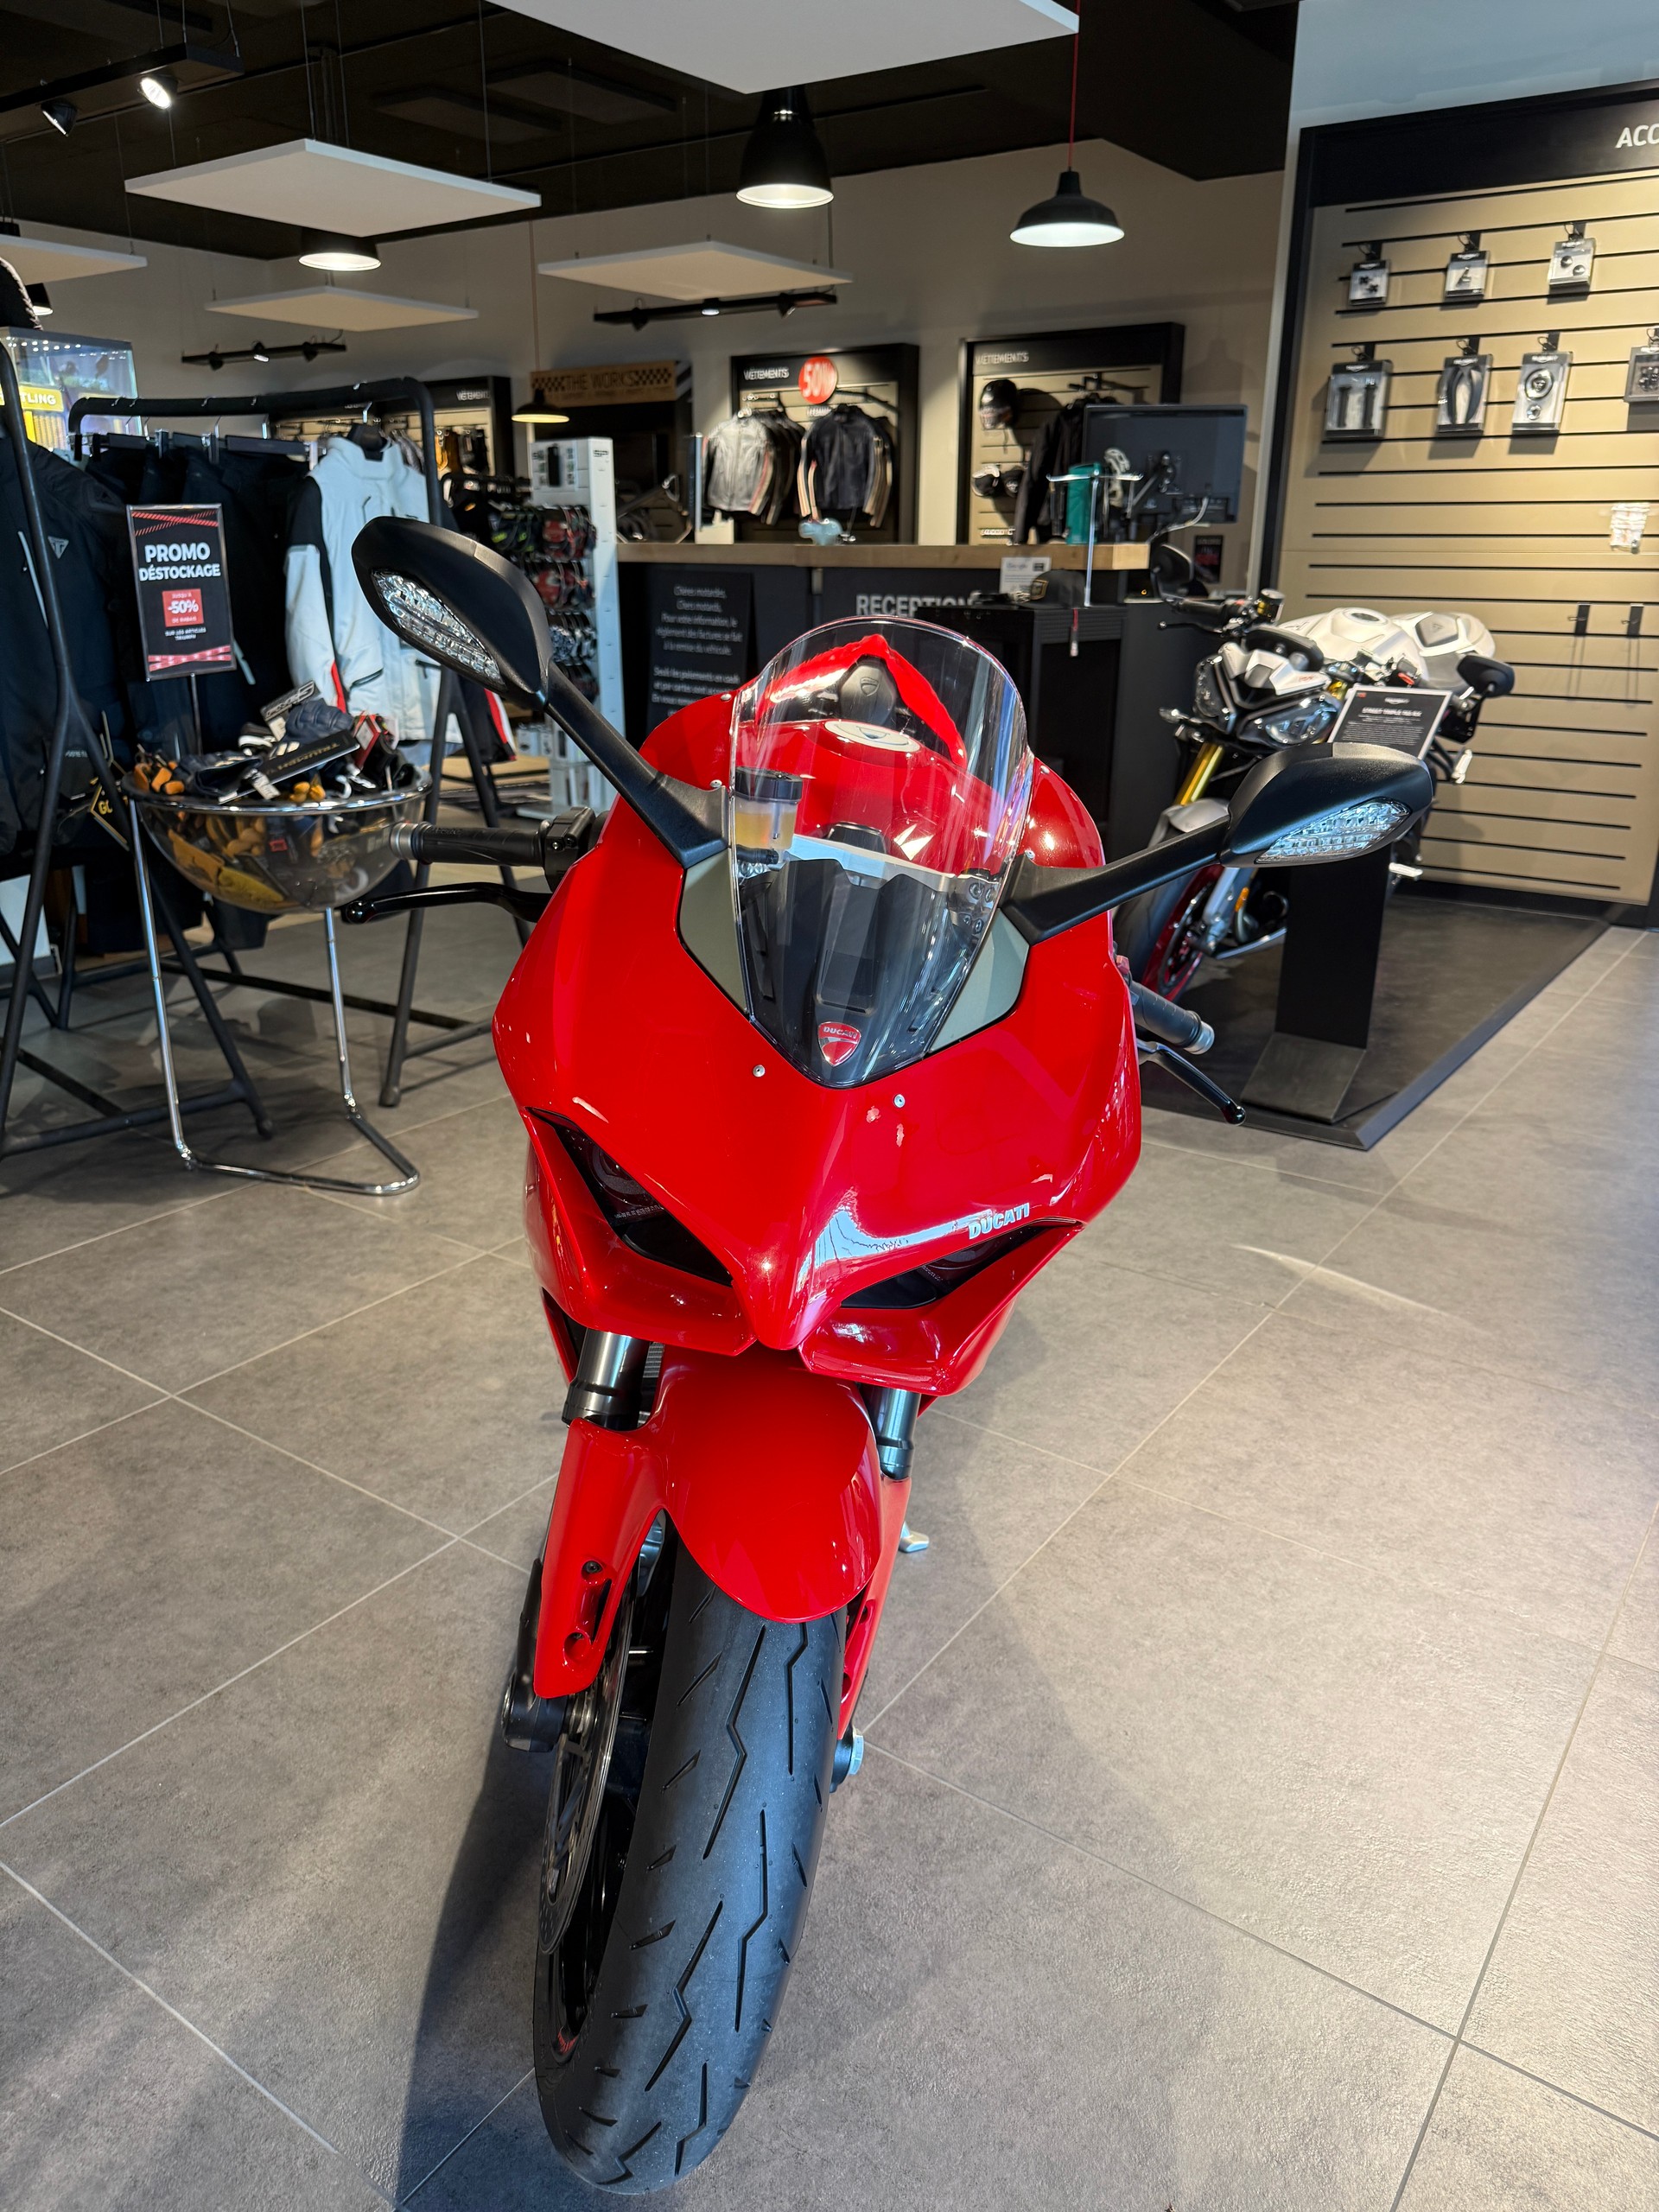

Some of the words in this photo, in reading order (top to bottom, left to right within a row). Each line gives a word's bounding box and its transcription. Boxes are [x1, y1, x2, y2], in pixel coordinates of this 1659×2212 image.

[145, 542, 211, 563] PROMO
[138, 563, 221, 582] DÉSTOCKAGE
[168, 599, 199, 614] -50%
[823, 1026, 857, 1039] DUCATI
[968, 1203, 1030, 1239] DUCATI
